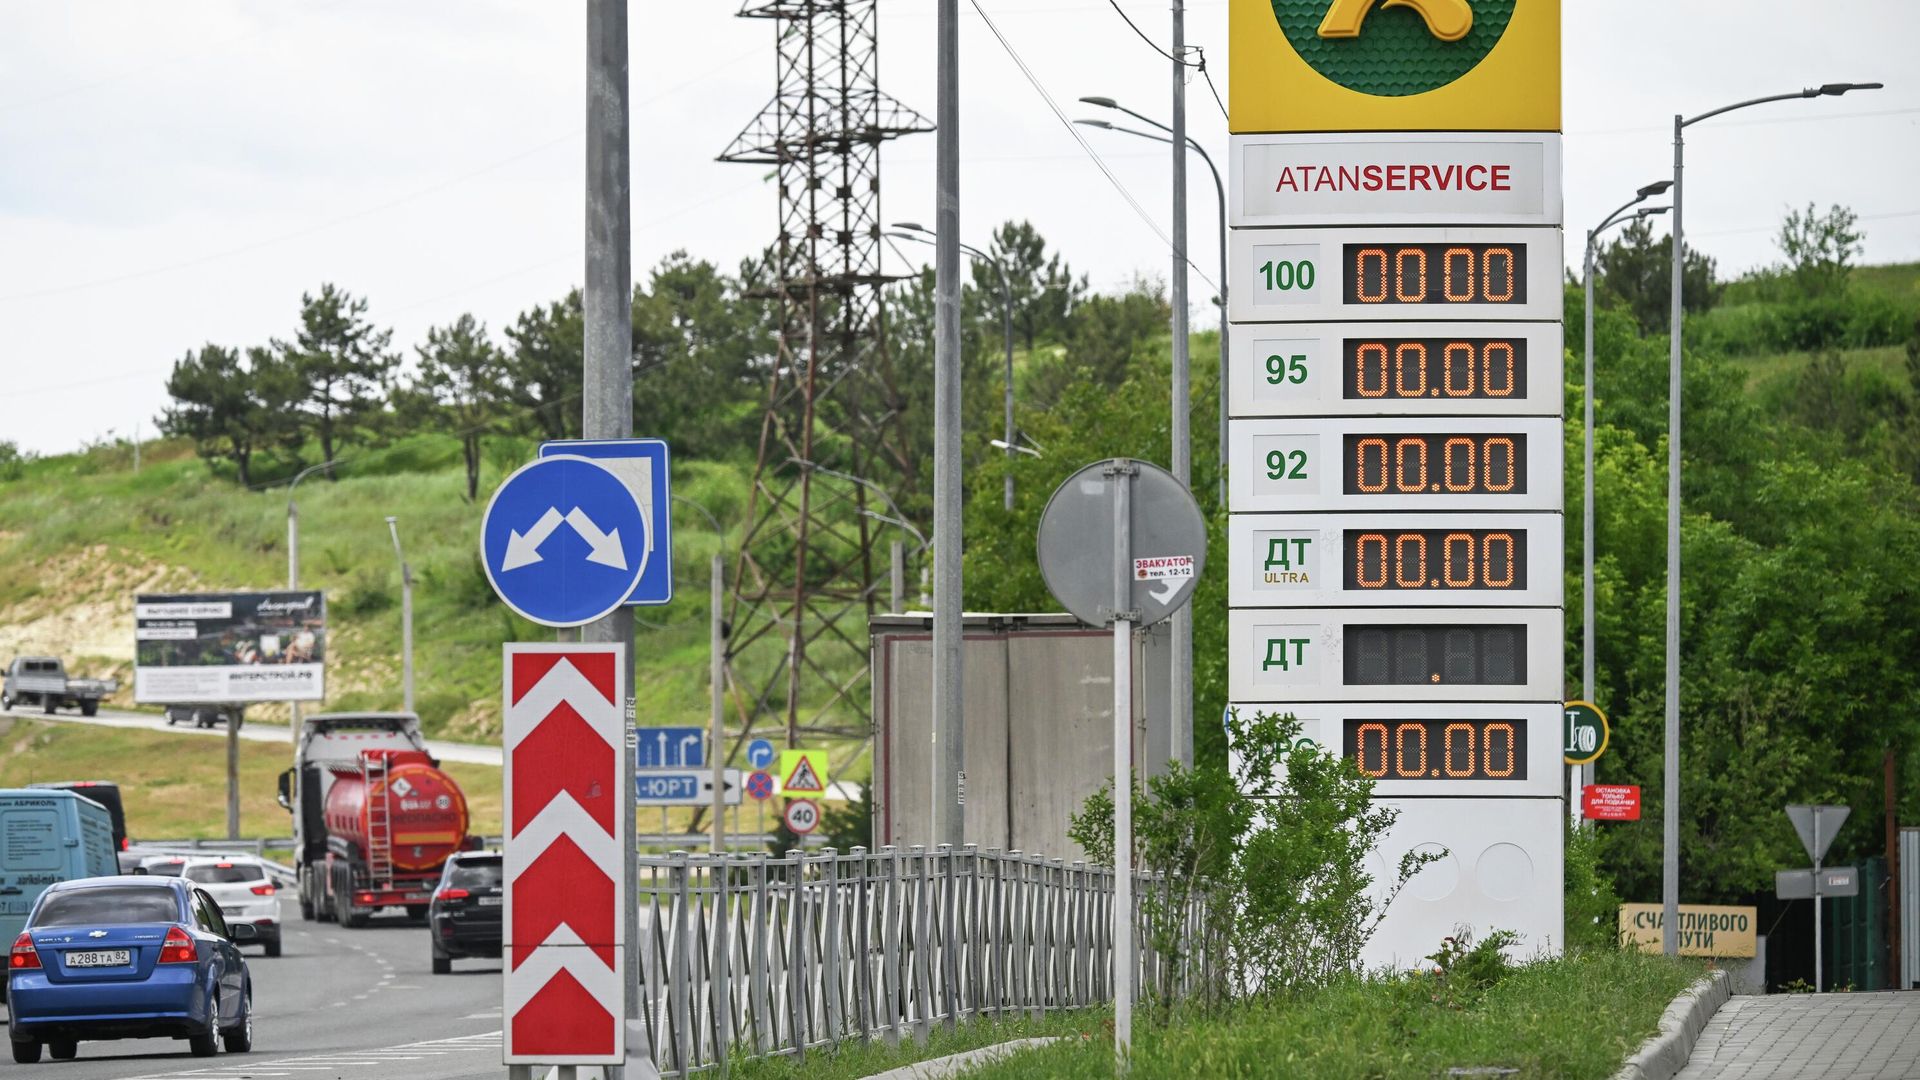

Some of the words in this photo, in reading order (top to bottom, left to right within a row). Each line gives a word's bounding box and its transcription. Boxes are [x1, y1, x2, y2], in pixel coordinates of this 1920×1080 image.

[1276, 165, 1511, 192] ATANSERVICE
[1259, 260, 1315, 290] 100
[1265, 354, 1308, 385] 95
[1357, 342, 1514, 397] 00.00
[1266, 450, 1308, 480] 92
[1357, 438, 1514, 492] 00.00
[1264, 538, 1312, 571] ДТ
[1357, 534, 1514, 588] 00.00
[1169, 568, 1190, 576] 12-12
[1264, 572, 1309, 584] ULTRA
[1262, 638, 1310, 671] ДТ
[1357, 723, 1514, 777] 00.00
[791, 810, 813, 823] 40
[1636, 911, 1748, 932] СЧАТЛИВОГО
